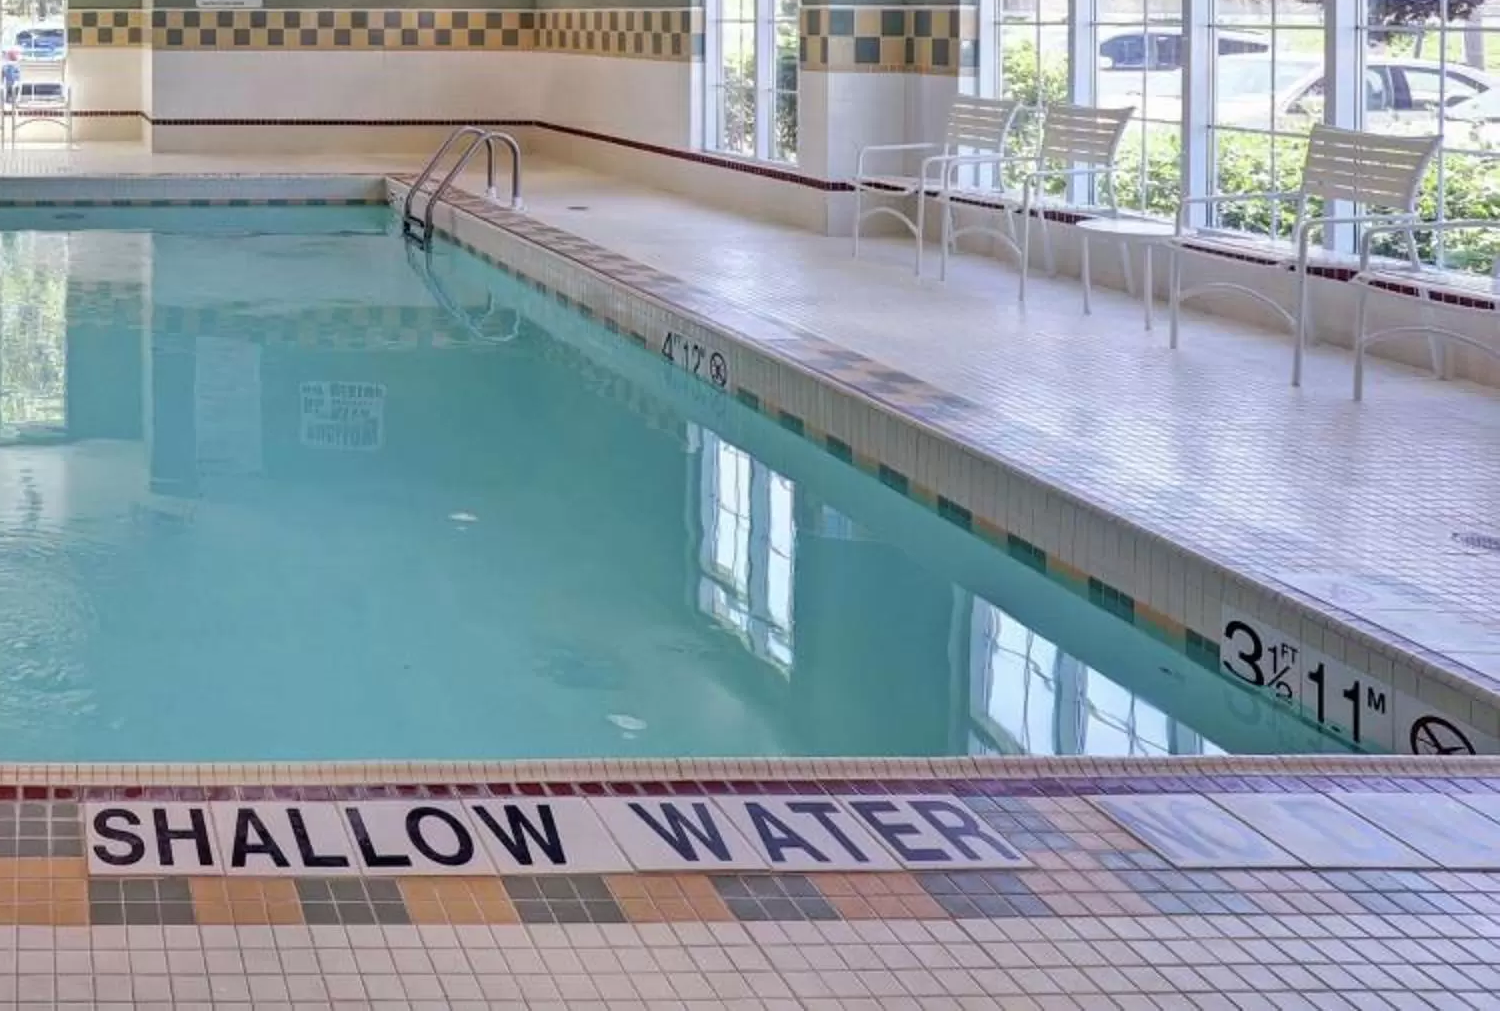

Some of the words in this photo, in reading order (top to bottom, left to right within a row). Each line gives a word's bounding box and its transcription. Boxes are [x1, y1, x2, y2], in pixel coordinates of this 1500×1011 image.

[1223, 620, 1264, 687] 3
[1367, 686, 1386, 715] M
[93, 804, 567, 867] SHALLOW
[627, 800, 1021, 863] WATER
